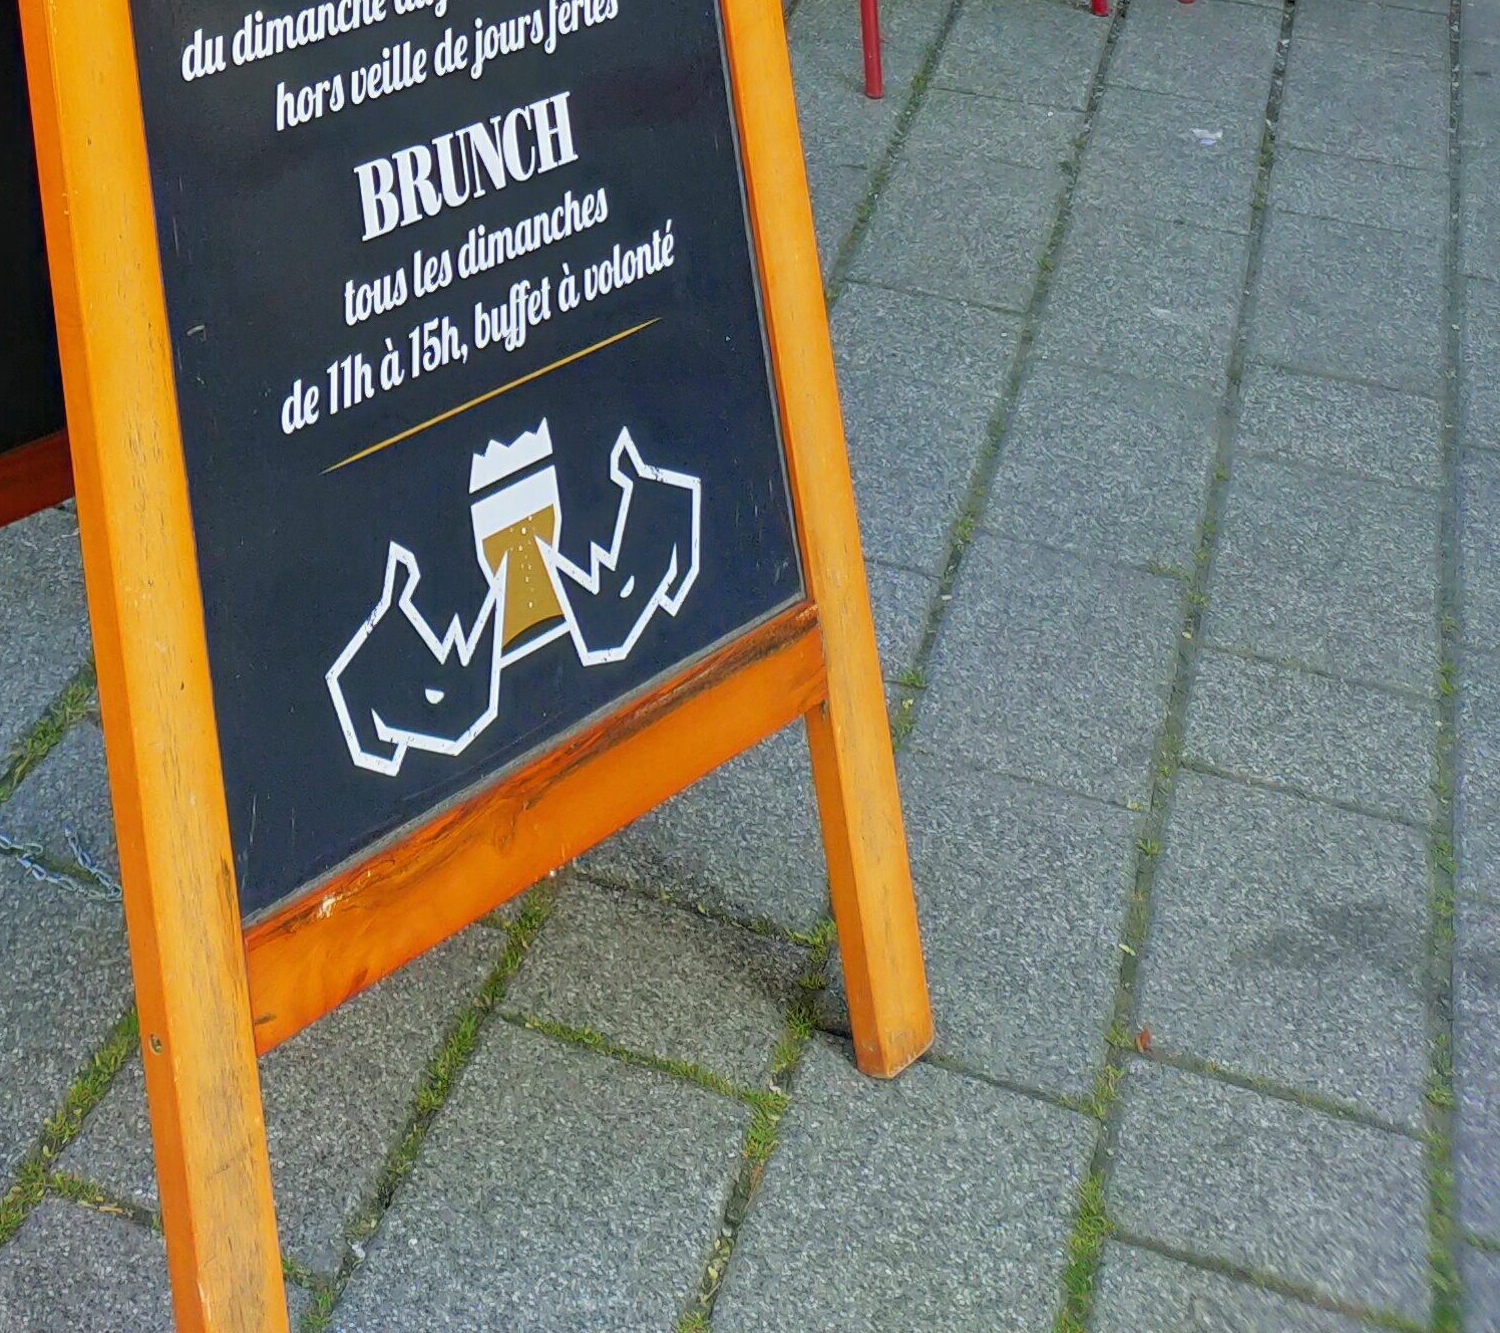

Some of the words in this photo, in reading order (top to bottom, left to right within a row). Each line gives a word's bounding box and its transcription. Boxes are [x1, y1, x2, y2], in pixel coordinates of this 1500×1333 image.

[181, 27, 227, 82] du
[275, 81, 346, 132] hors
[350, 39, 427, 106] veille
[433, 27, 469, 79] de
[469, 9, 544, 80] jours
[353, 90, 579, 242] BRUNCH
[280, 380, 320, 435] de
[325, 351, 375, 416] 11h
[380, 336, 405, 391] à
[408, 316, 469, 381] 15h,
[473, 277, 552, 351] buffet
[557, 262, 582, 311] à
[583, 218, 676, 300] volonté
[343, 267, 408, 327] tous
[412, 248, 454, 300] les
[457, 187, 609, 280] dimanches
